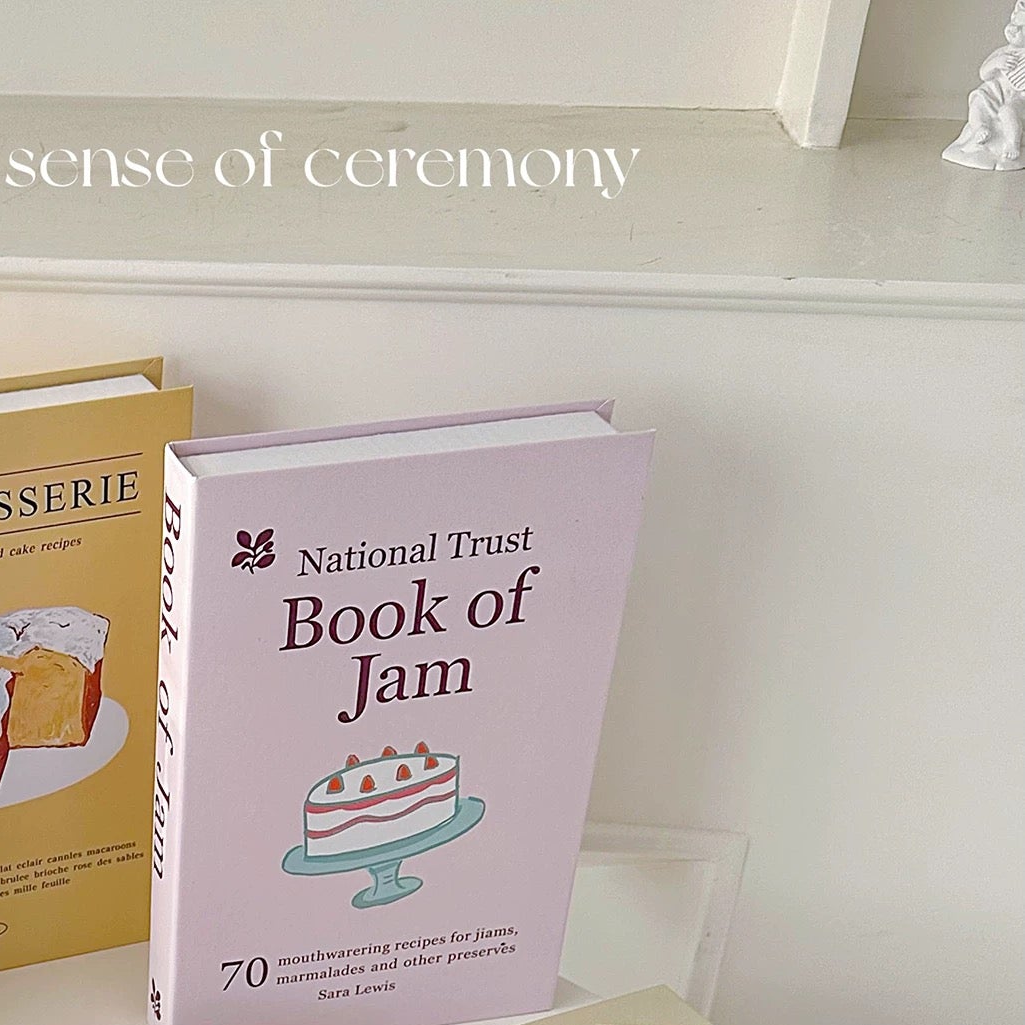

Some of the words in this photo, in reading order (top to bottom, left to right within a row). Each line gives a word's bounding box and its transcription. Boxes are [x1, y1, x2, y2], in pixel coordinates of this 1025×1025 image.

[8, 542, 37, 558] cake
[40, 535, 83, 555] recipes
[159, 491, 182, 655] Book
[296, 532, 438, 578] National
[446, 525, 535, 561] Trust
[278, 577, 450, 652] Book
[466, 564, 542, 629] of
[336, 652, 474, 725] Jam
[157, 677, 174, 757] of
[153, 760, 171, 881] Jam
[0, 873, 30, 887] brulee
[34, 865, 70, 879] brioche
[73, 860, 93, 872] rose
[96, 856, 113, 867] des
[116, 850, 145, 864] sables
[16, 857, 44, 871] eclair
[86, 840, 137, 858] macaroons
[13, 883, 38, 896] mille
[41, 876, 72, 890] feuille
[219, 956, 270, 992] 70
[277, 943, 392, 968] mouthwarering
[394, 934, 447, 952] recipes
[449, 929, 472, 944] for
[275, 963, 366, 987] marmalades
[369, 957, 399, 974] and
[402, 953, 442, 970] other
[445, 942, 517, 966] preserves
[317, 987, 351, 1002] Sara
[354, 980, 397, 997] Lewis
